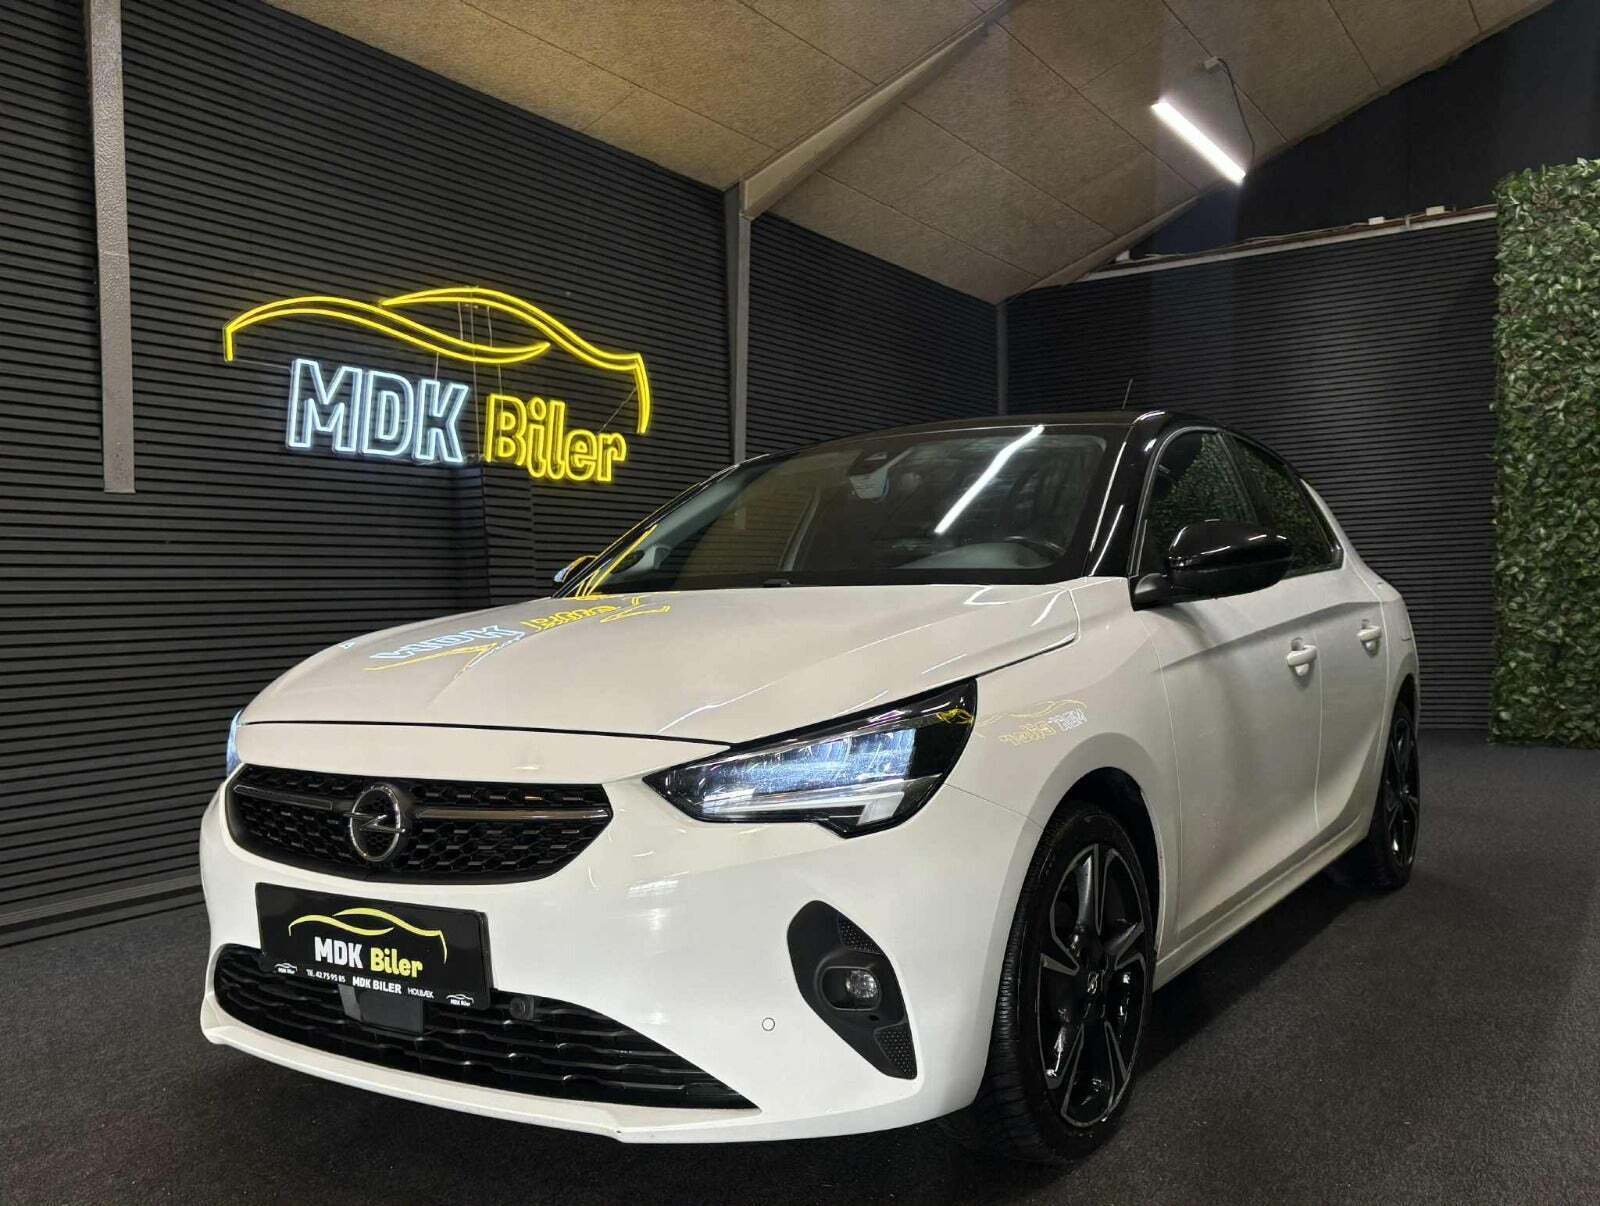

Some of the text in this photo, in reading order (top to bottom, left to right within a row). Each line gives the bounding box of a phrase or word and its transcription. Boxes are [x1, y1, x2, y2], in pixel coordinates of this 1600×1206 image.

[286, 358, 627, 482] MDK Biler
[314, 937, 423, 978] MDK Biler
[352, 976, 402, 994] MDK BILER
